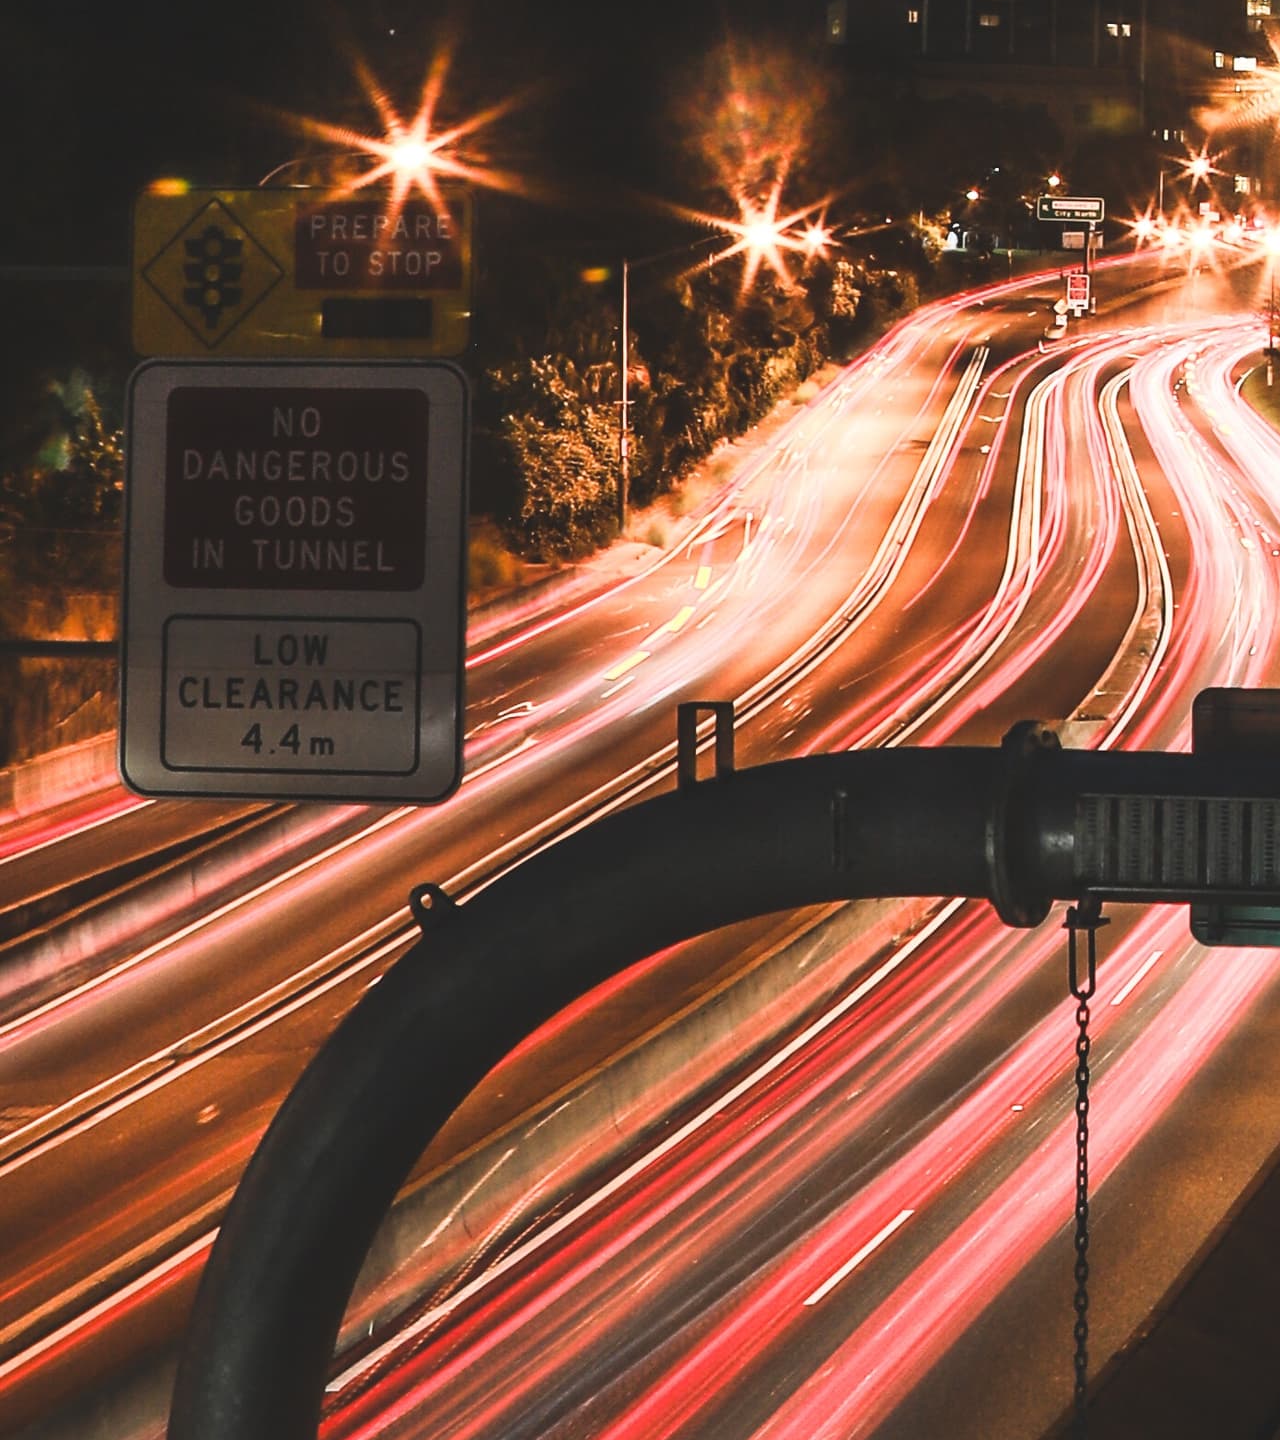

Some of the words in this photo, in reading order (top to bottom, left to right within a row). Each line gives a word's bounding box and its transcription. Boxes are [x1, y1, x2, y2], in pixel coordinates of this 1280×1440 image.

[310, 214, 453, 240] PREPARE
[316, 251, 350, 277] TO
[367, 250, 443, 277] STOP
[271, 406, 321, 438] NO
[182, 449, 410, 483] DANGEROUS
[234, 495, 355, 527] GOODS
[192, 538, 225, 569] IN
[252, 539, 396, 572] TUNNEL
[253, 633, 329, 666] LOW
[178, 676, 404, 712] CLEARANCE
